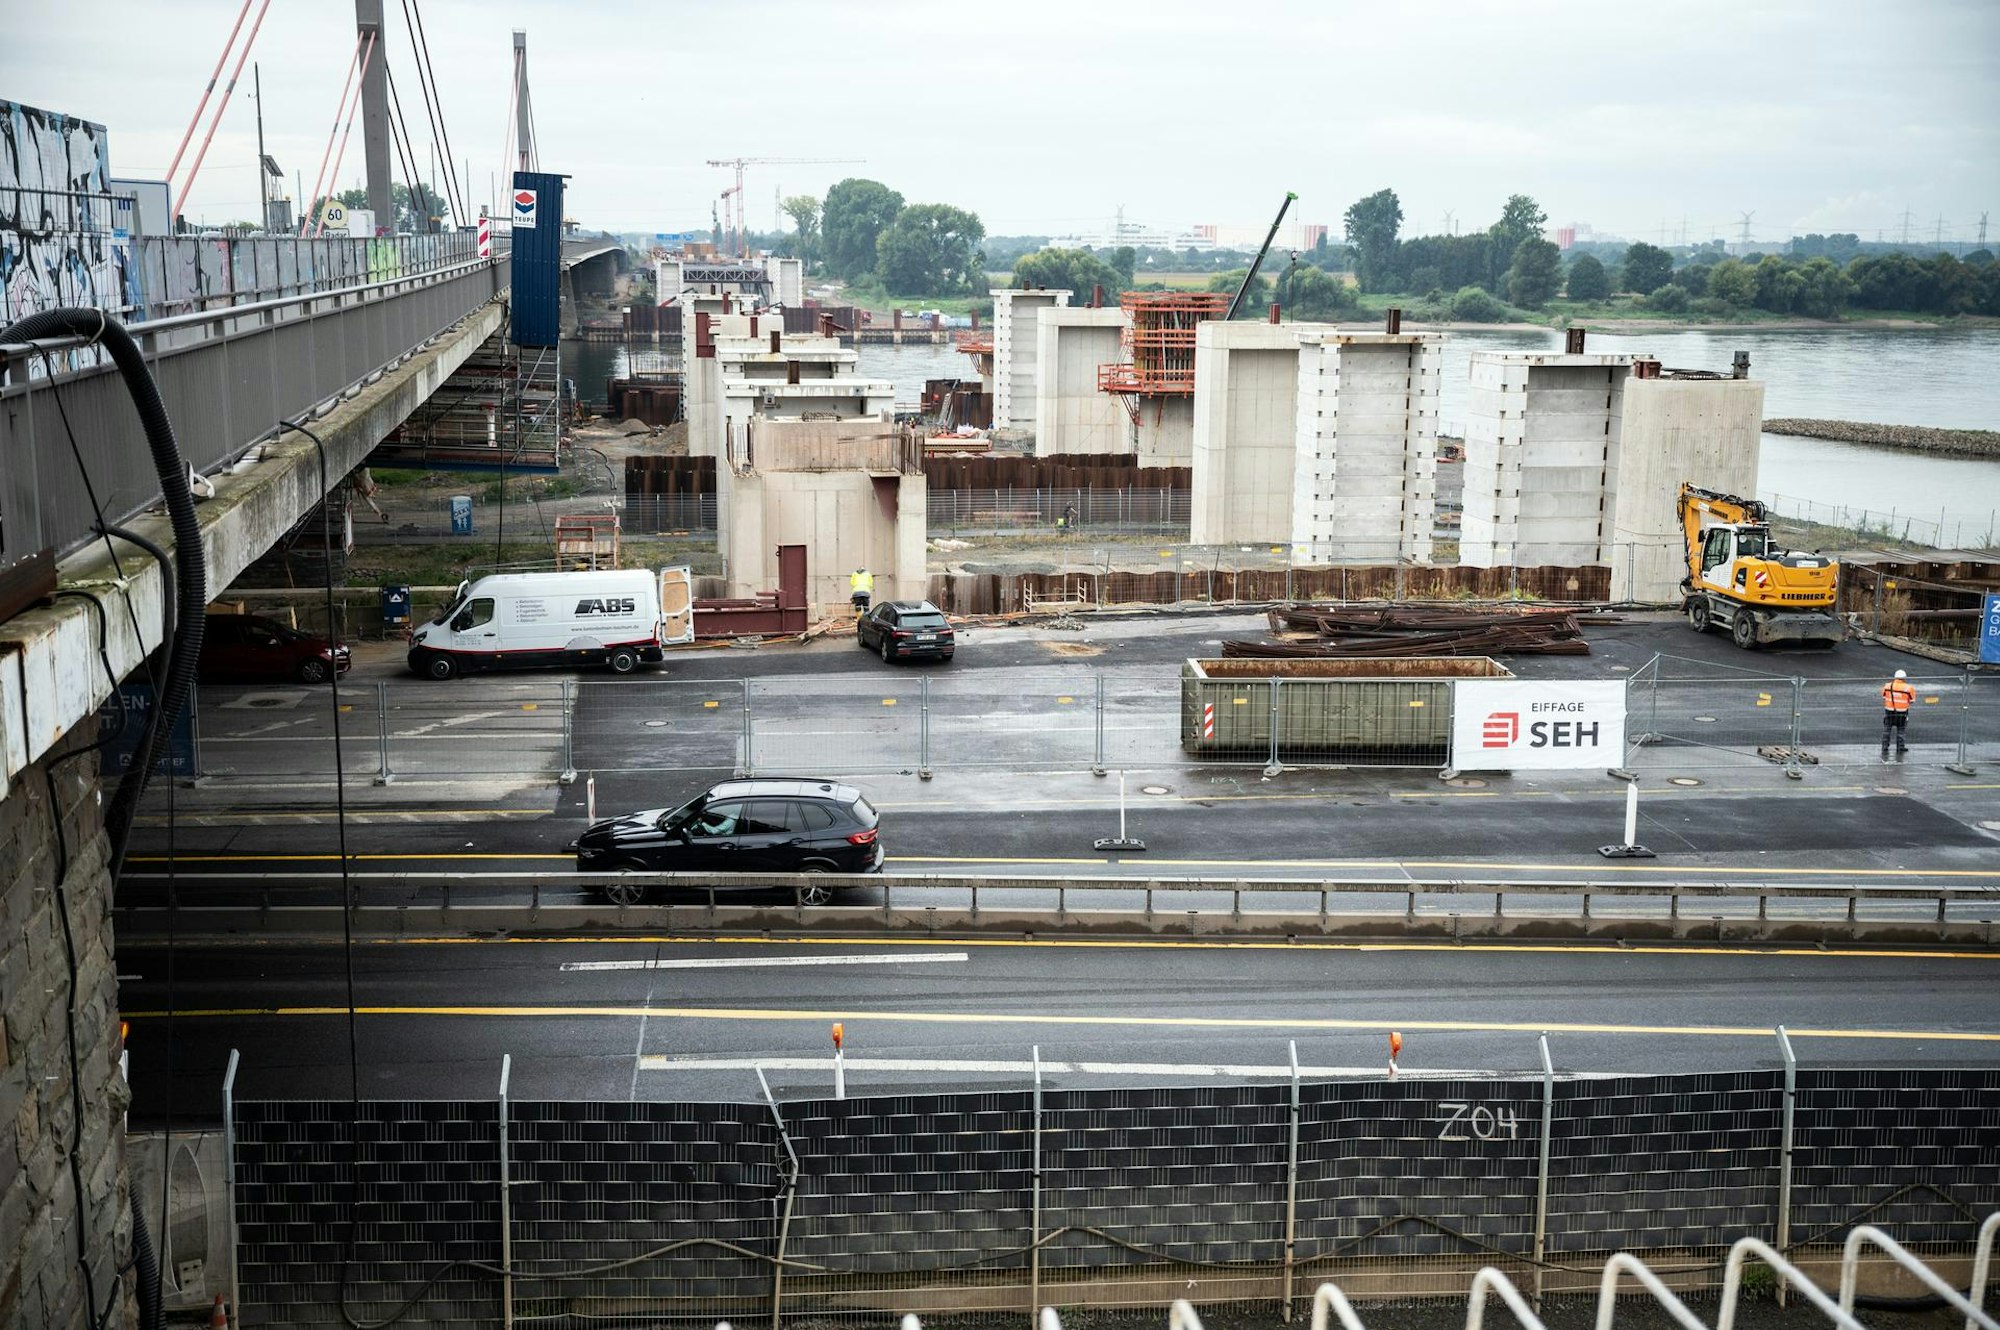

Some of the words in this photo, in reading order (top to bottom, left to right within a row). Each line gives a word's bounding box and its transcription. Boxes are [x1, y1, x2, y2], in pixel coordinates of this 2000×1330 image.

[328, 209, 342, 220] 60
[325, 231, 347, 239] Radar
[589, 598, 635, 613] ABS
[1531, 702, 1585, 712] EIFFAGE
[1529, 721, 1599, 748] SEH
